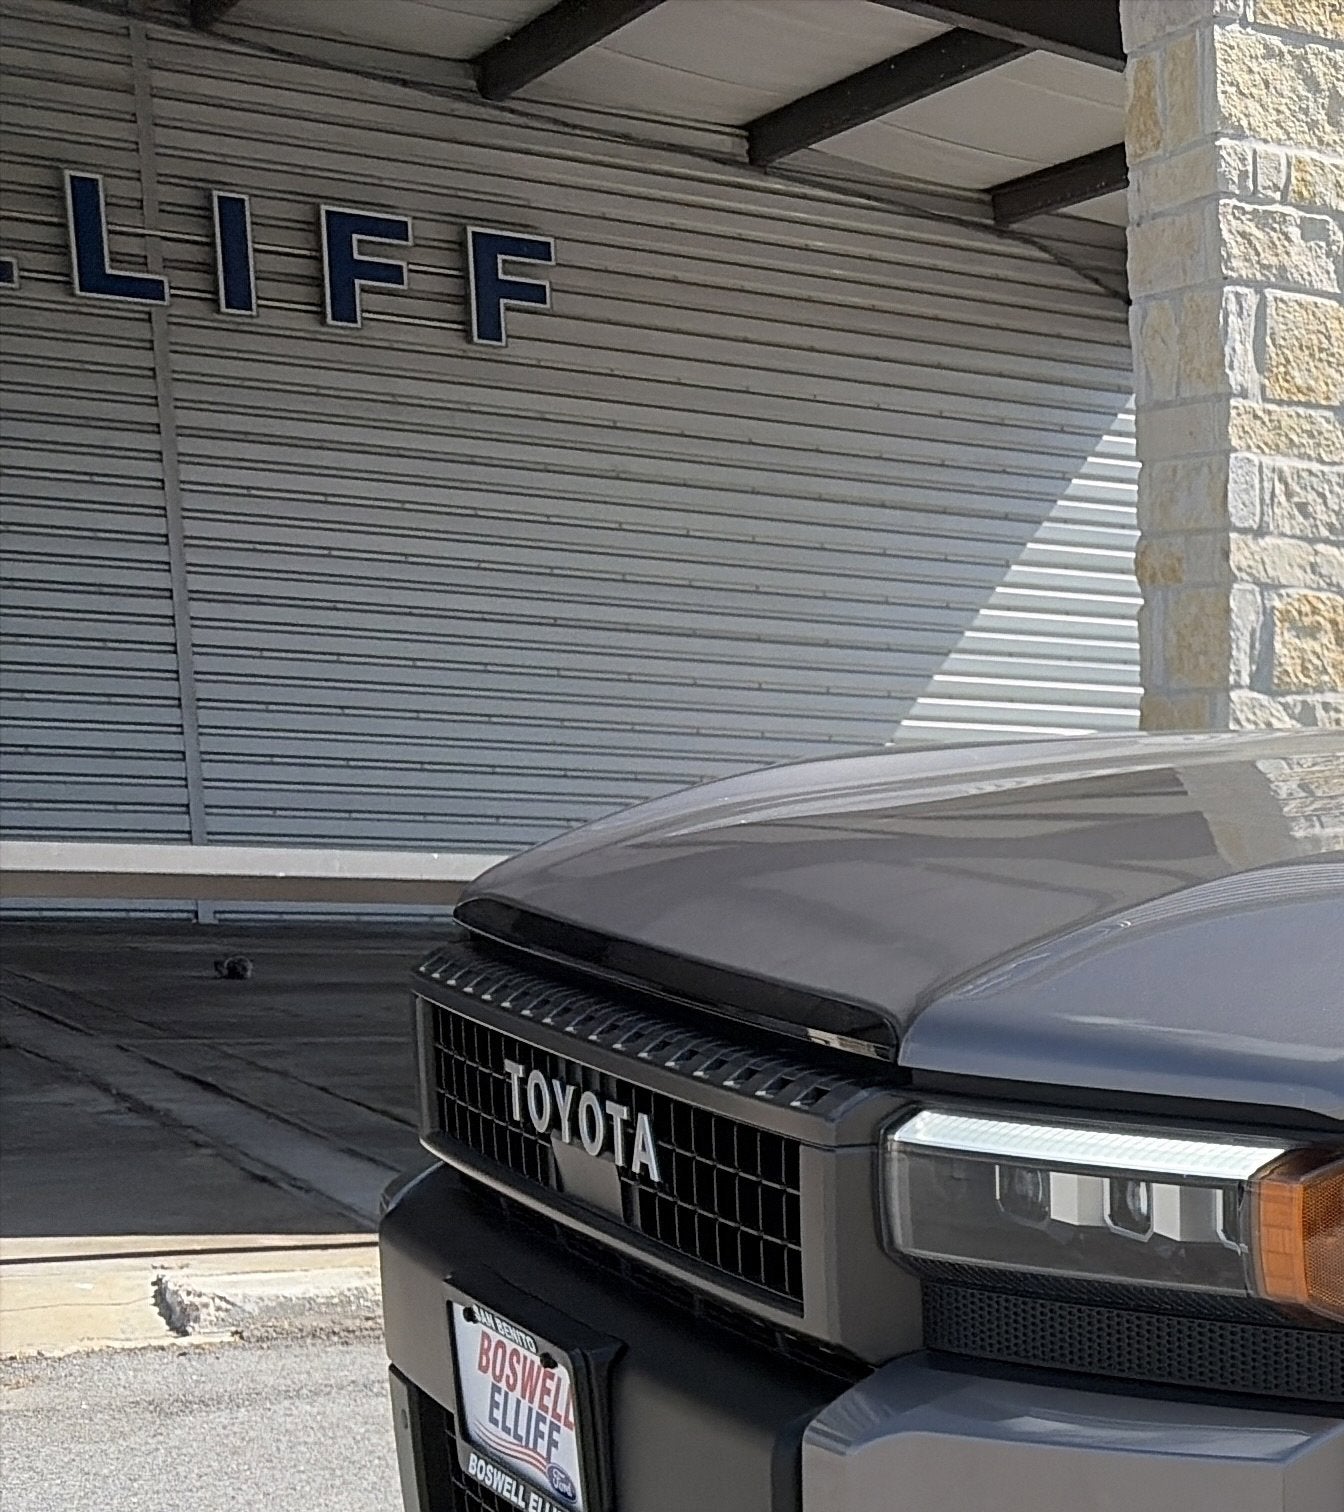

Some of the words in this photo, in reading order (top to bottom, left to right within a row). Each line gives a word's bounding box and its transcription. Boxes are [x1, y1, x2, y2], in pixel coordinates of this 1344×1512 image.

[0, 168, 556, 346] LIFF
[504, 1058, 661, 1182] TOYOTA
[495, 1316, 537, 1354] BENITO
[477, 1330, 575, 1432] BOSWELL
[488, 1381, 561, 1463] ELLIFF
[468, 1453, 526, 1508] BOSWELL
[552, 1467, 574, 1498] Ford
